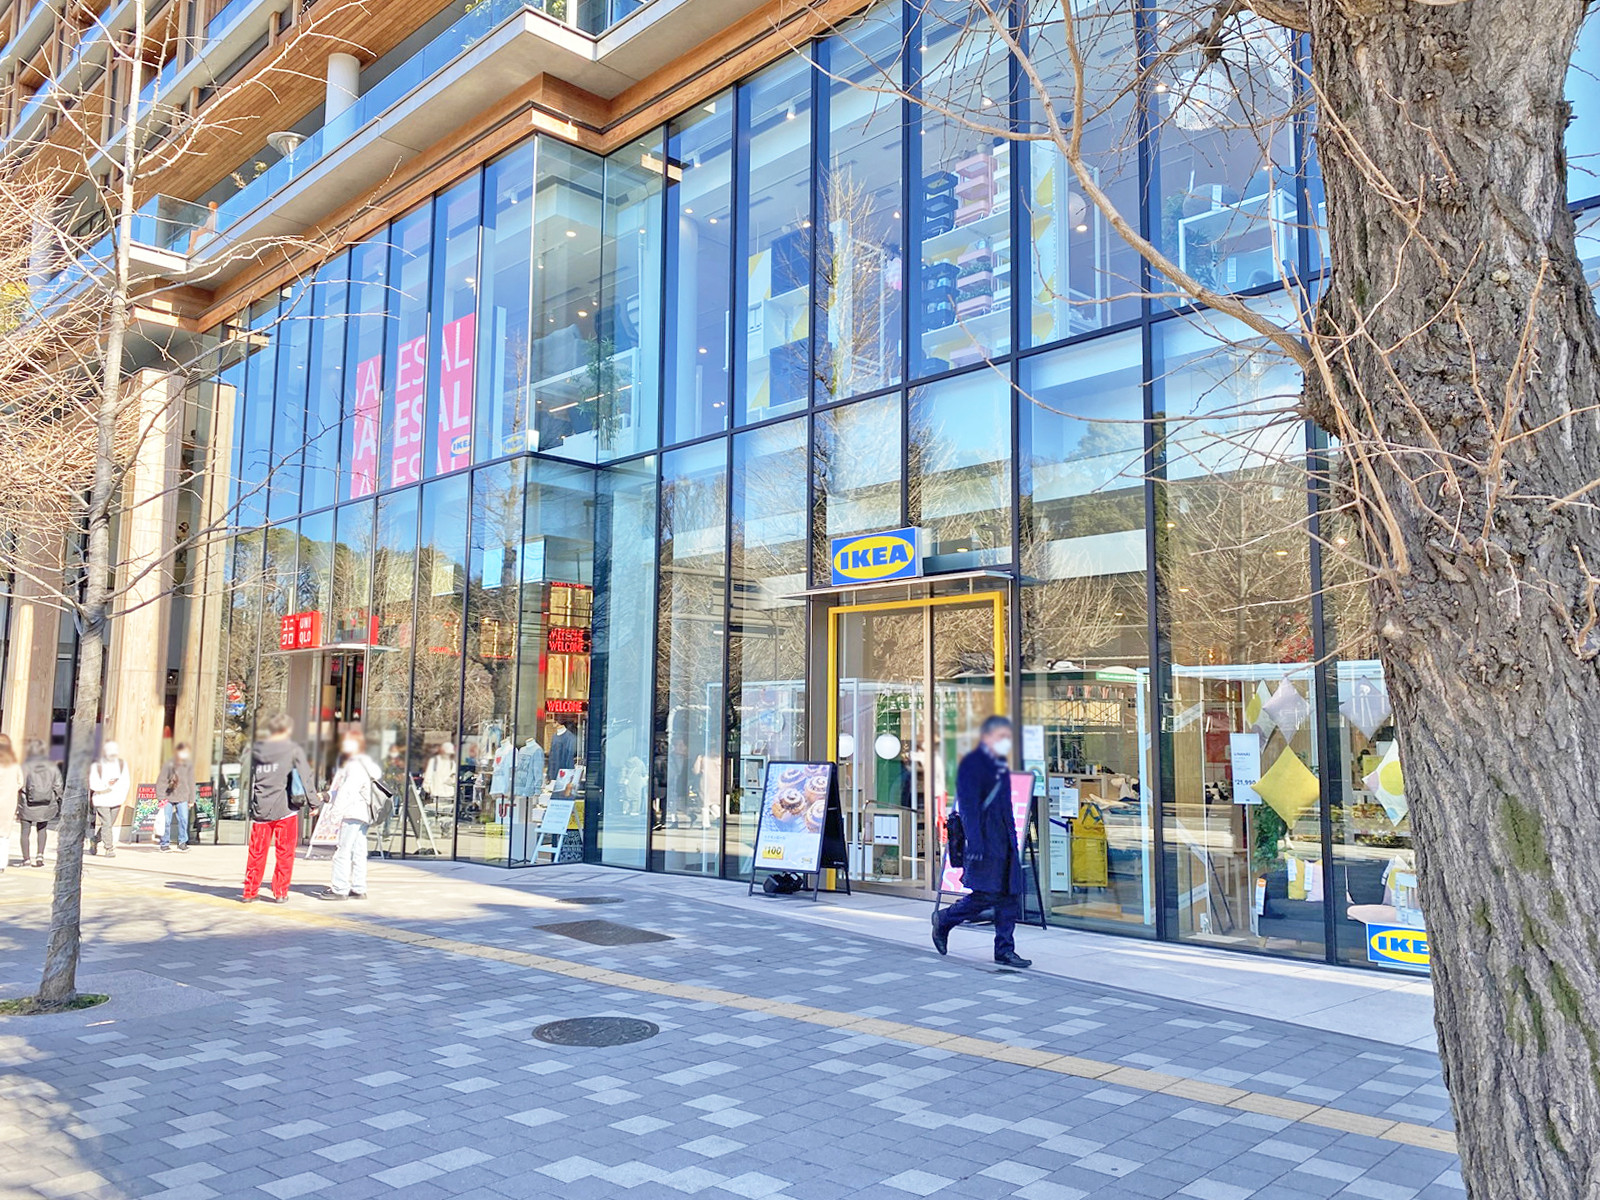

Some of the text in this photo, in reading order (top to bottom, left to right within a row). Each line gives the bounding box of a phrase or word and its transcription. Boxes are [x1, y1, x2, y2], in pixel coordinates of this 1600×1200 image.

[356, 361, 379, 406] A
[353, 415, 376, 460] A
[453, 440, 471, 451] IKE
[840, 543, 909, 570] IKEA
[299, 616, 312, 629] UNI
[299, 630, 312, 645] QLO
[549, 640, 584, 652] WELCOME
[546, 700, 583, 713] WELCOME
[1377, 935, 1430, 955] IKE
